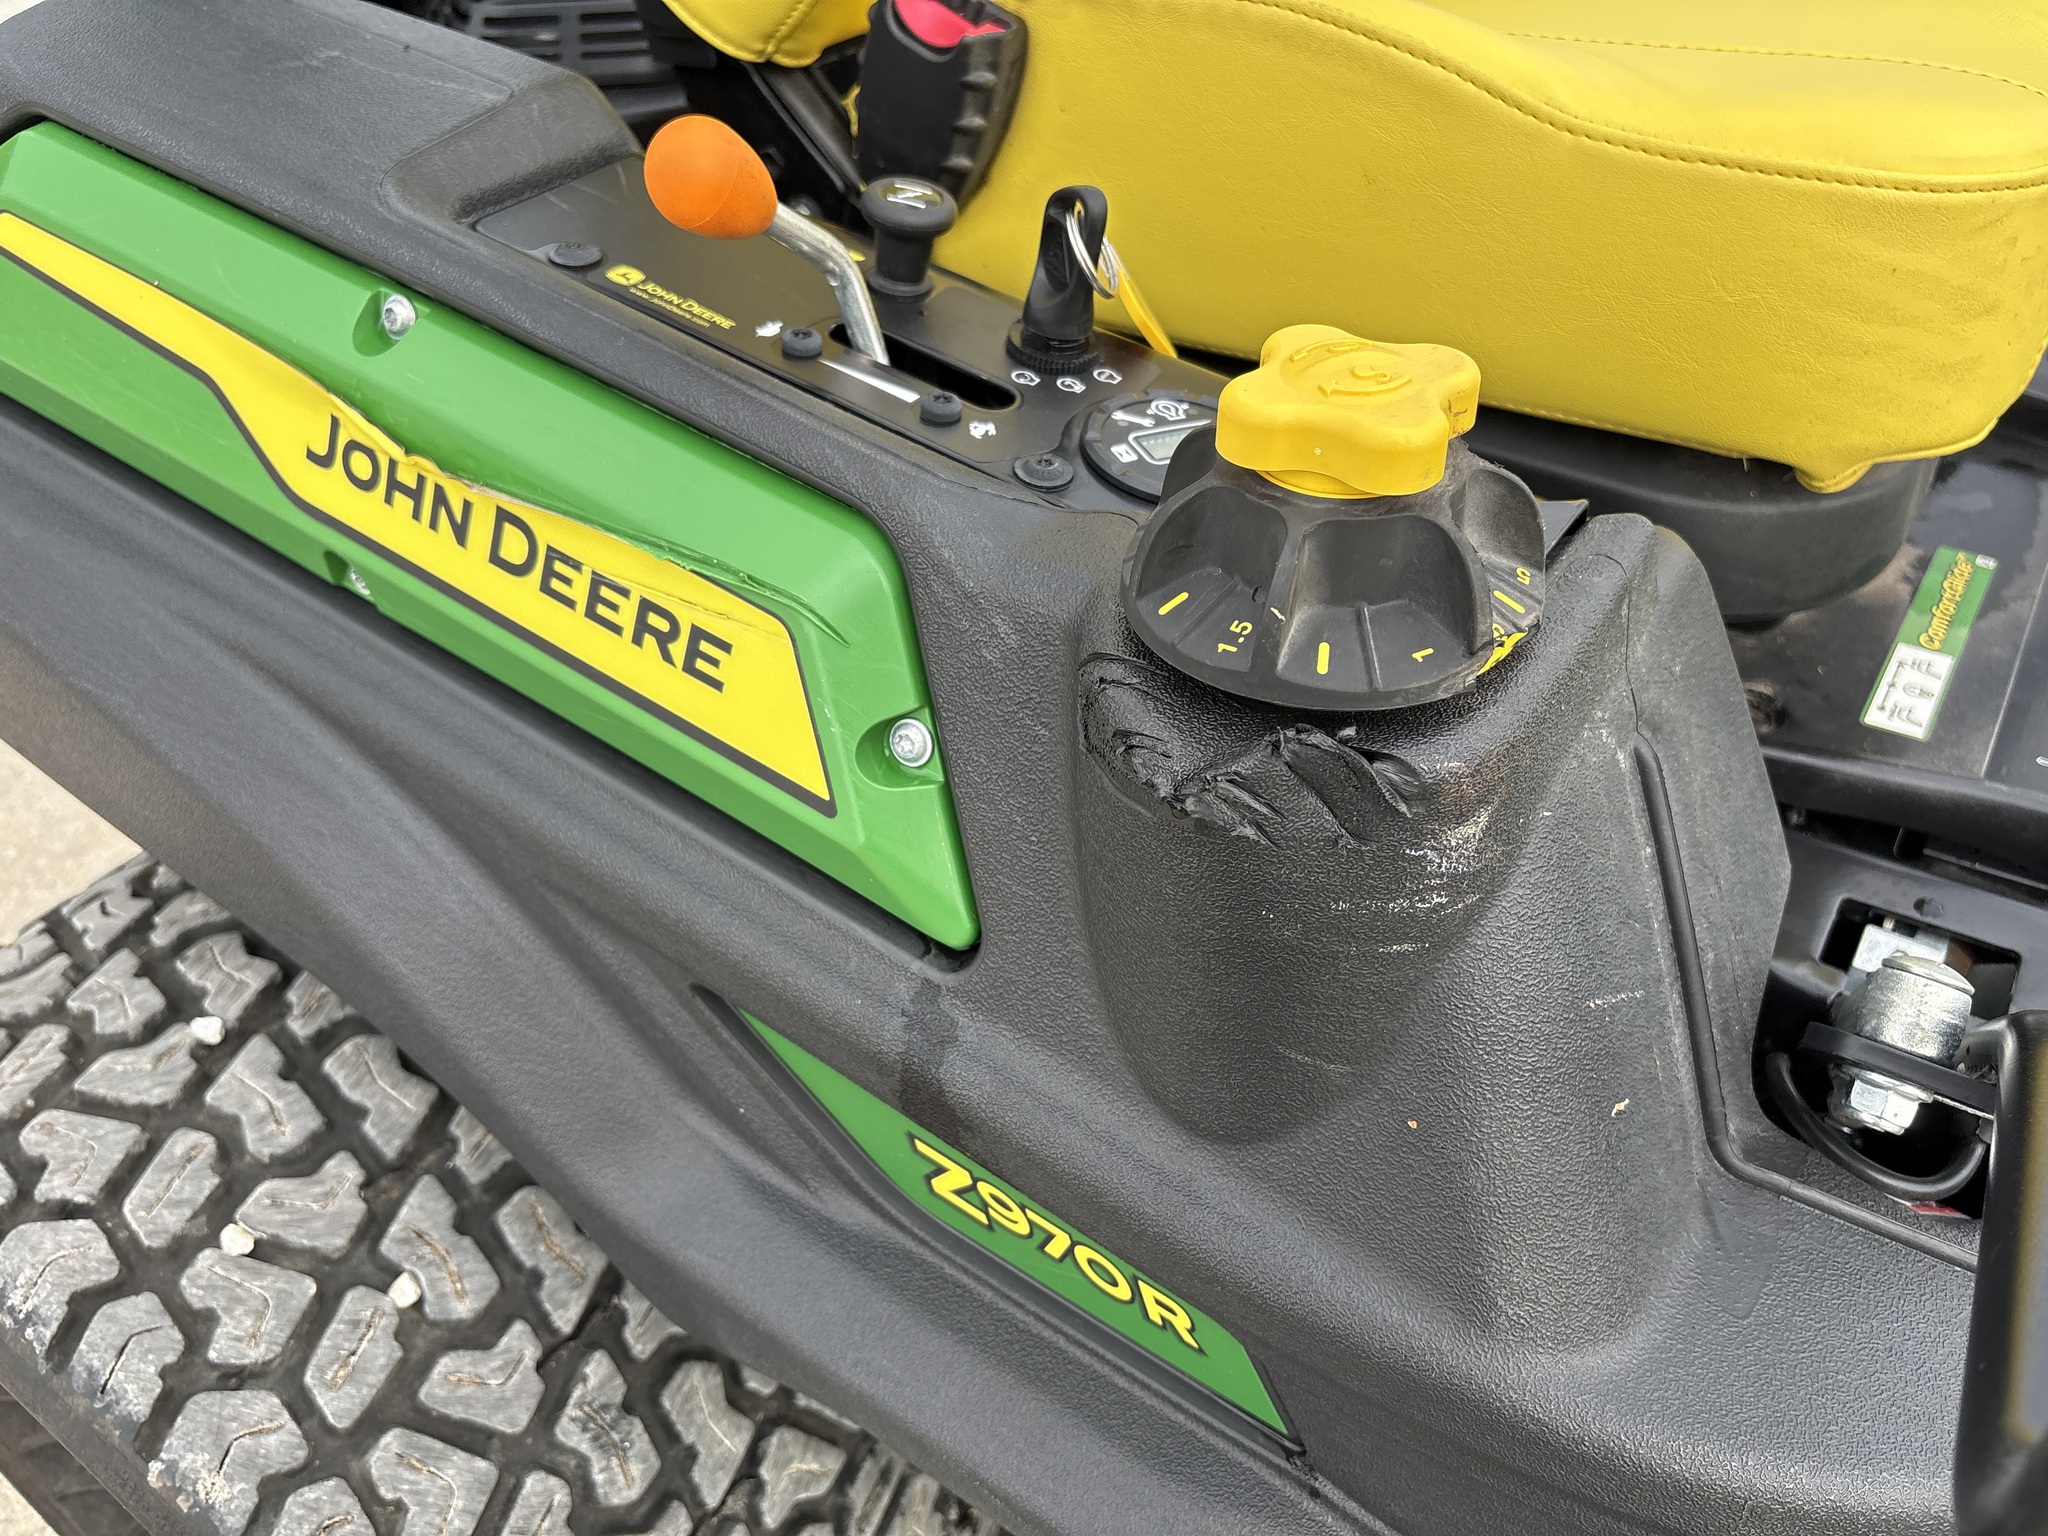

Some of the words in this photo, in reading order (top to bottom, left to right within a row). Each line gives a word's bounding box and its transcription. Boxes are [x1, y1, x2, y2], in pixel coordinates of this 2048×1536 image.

[637, 281, 682, 305] JOHN
[682, 299, 736, 329] DEERE
[306, 413, 474, 550] JOHN
[488, 504, 734, 694] DEERE
[1217, 619, 1253, 653] 1.5
[1411, 647, 1435, 663] 1
[908, 1132, 1207, 1357] Z970R
